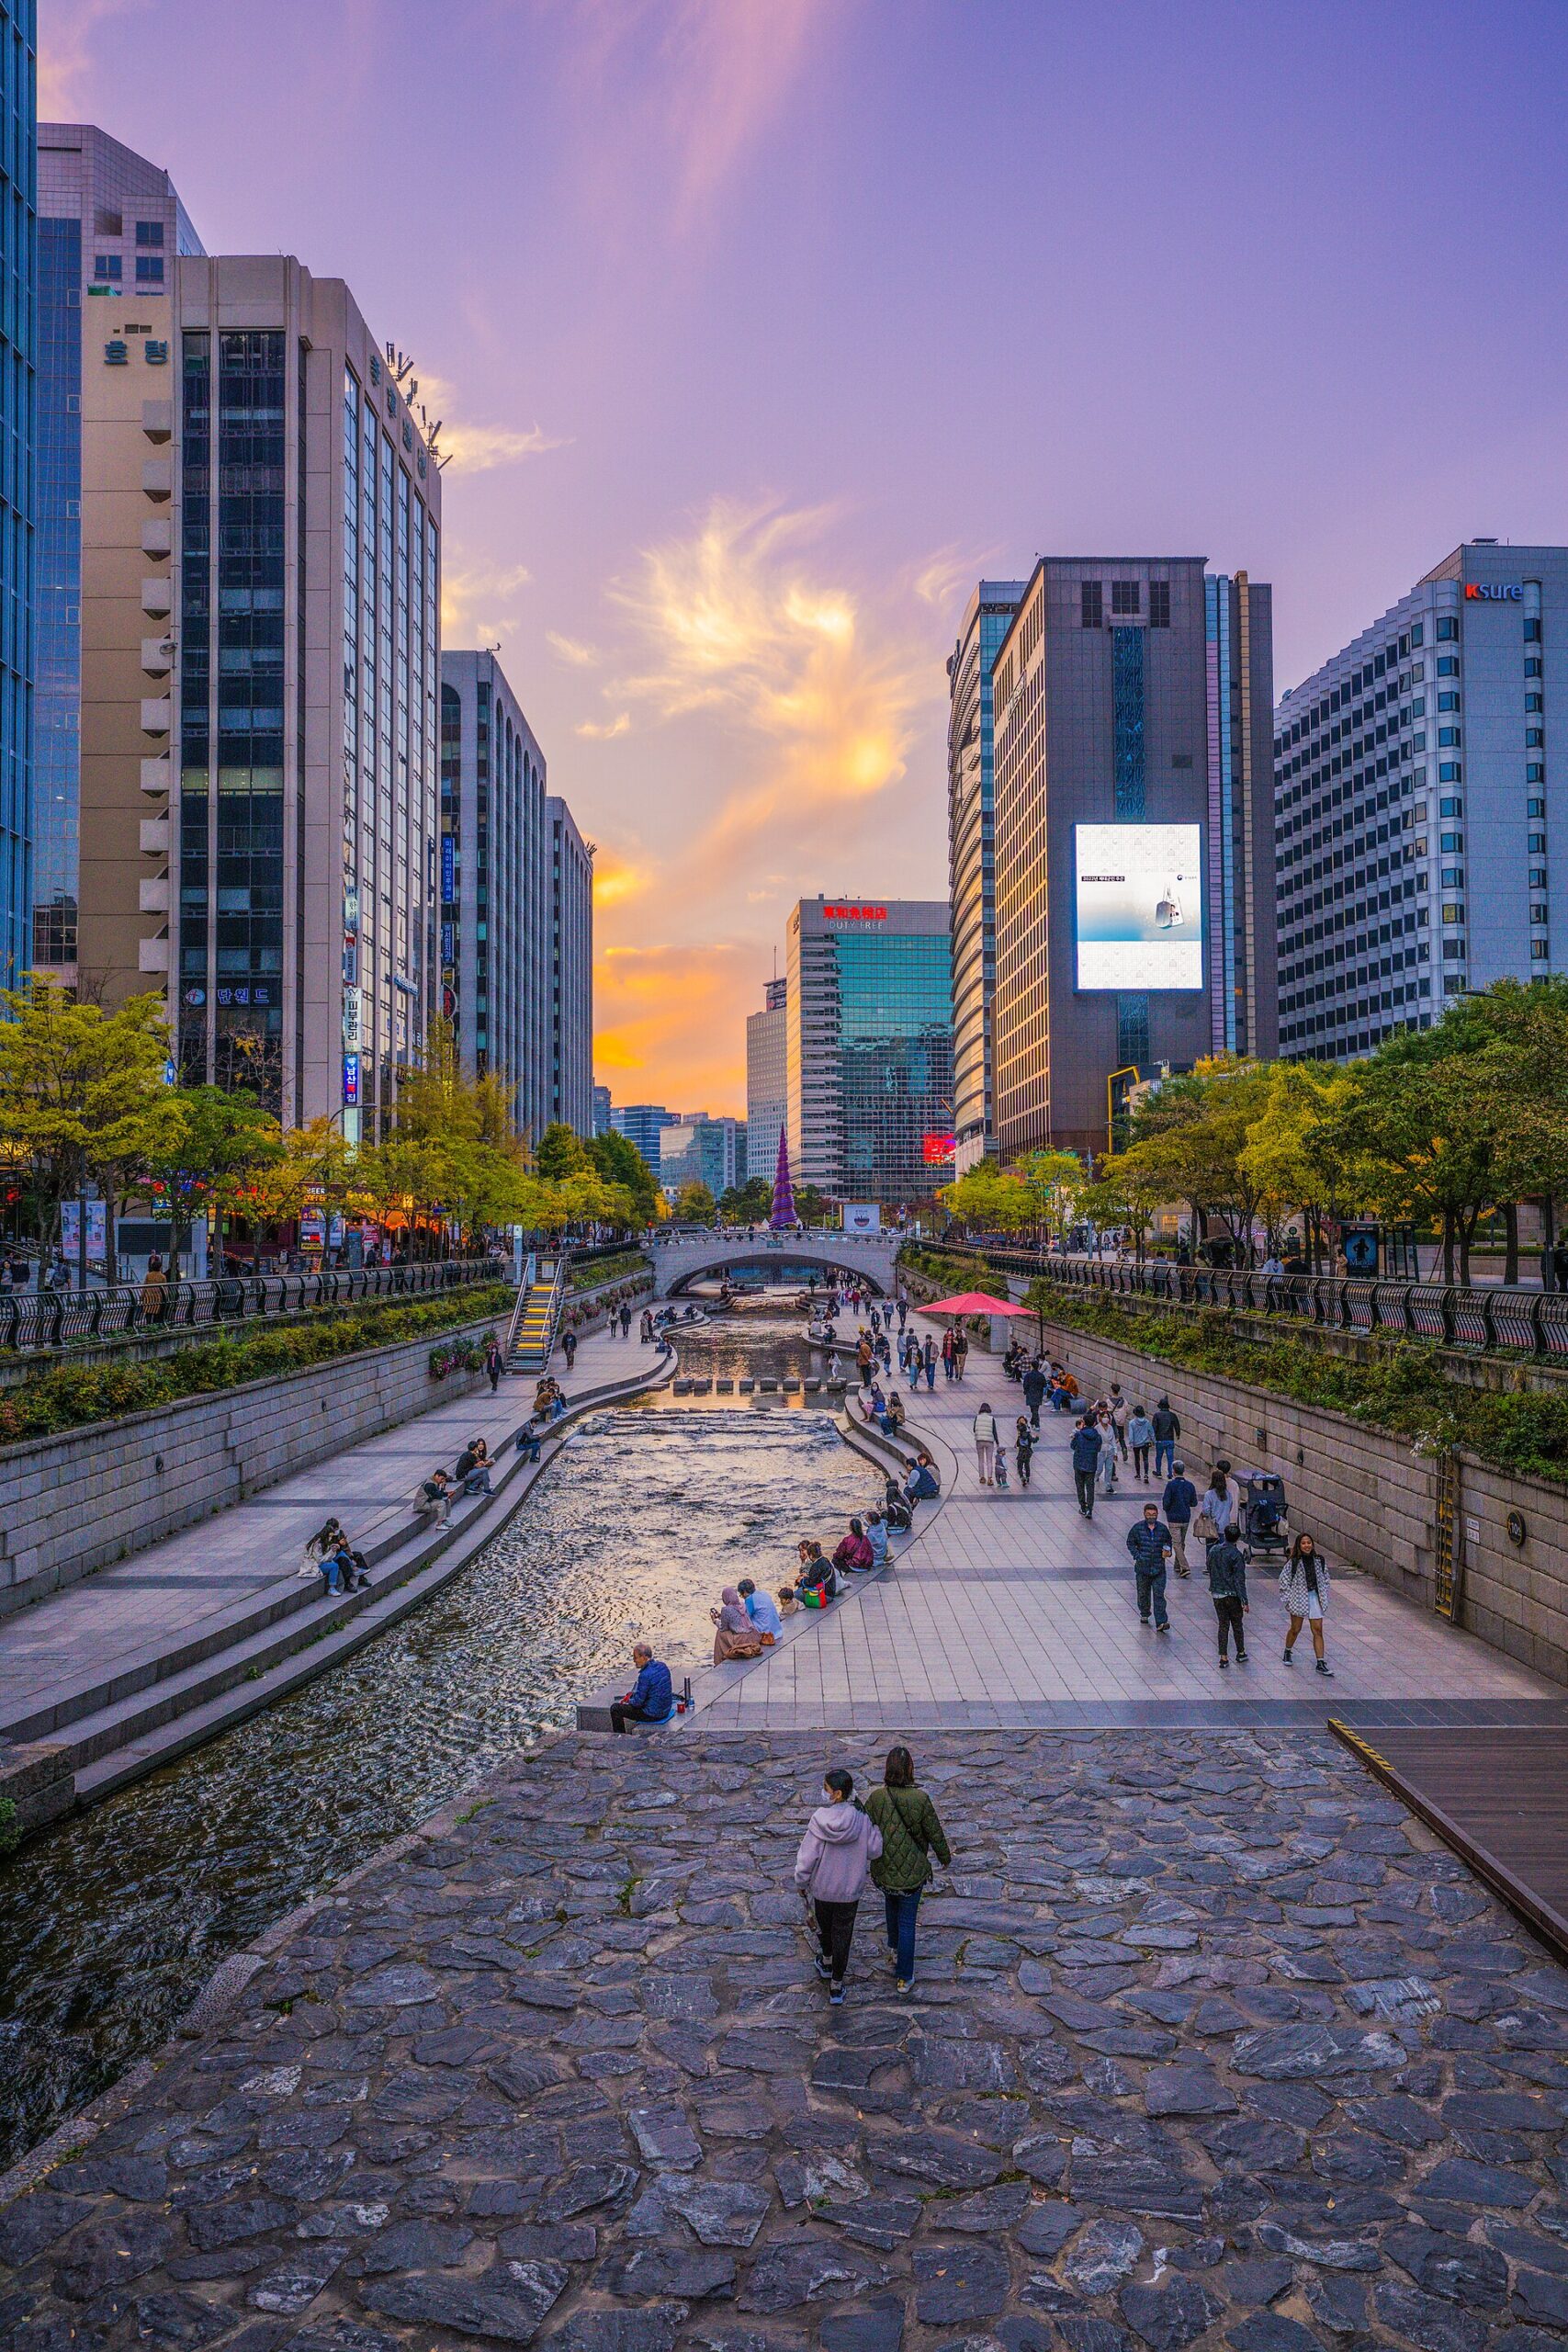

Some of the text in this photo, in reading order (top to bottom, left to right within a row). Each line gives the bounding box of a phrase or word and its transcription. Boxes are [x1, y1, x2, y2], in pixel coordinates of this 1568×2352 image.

[829, 921, 883, 930] DUTY FREE
[217, 988, 270, 1005] 단월드
[347, 1001, 358, 1041] 피부관리
